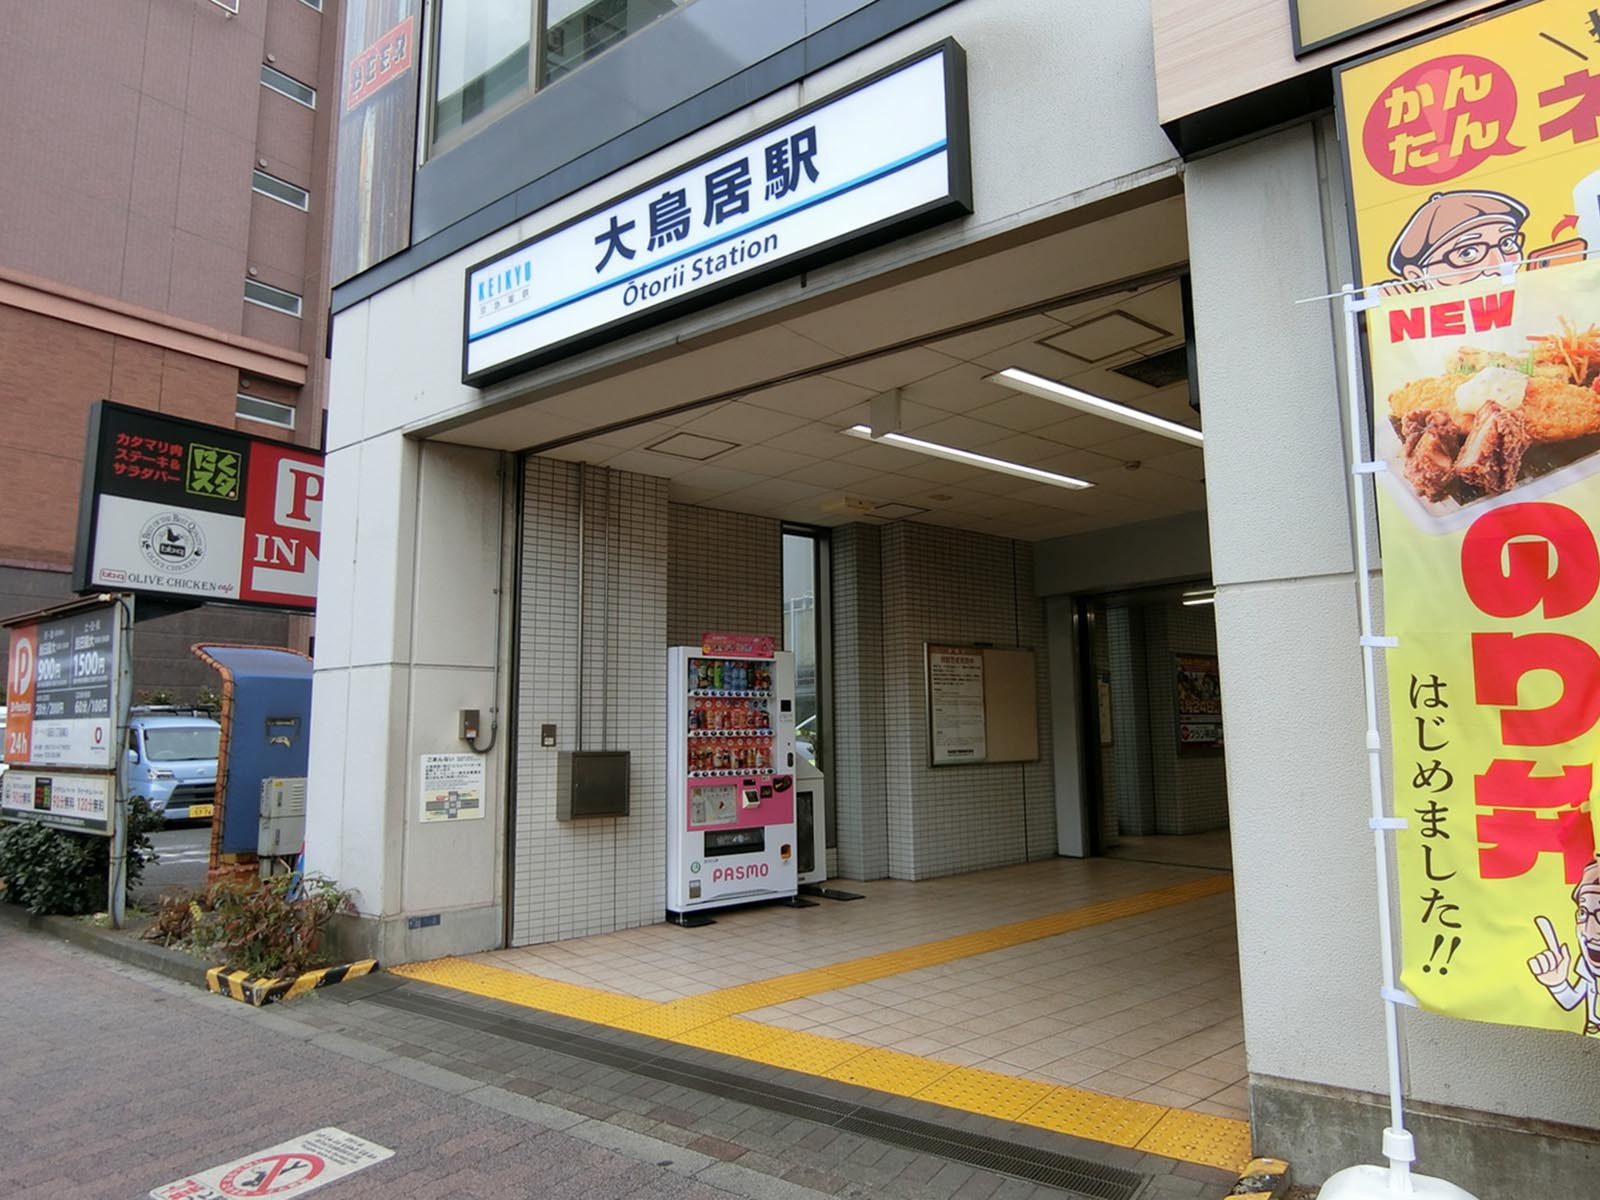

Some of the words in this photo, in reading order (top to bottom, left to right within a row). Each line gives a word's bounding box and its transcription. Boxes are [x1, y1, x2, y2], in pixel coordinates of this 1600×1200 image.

[352, 33, 407, 95] BEER
[1385, 65, 1493, 128] かん
[1388, 112, 1499, 175] たん
[594, 125, 820, 274] 大鳥居駅
[478, 260, 532, 302] KEIKYU
[622, 264, 685, 307] Ōtorii
[691, 233, 778, 282] Station
[1389, 289, 1516, 344] NEW
[116, 432, 184, 457] カタマリ肉
[112, 462, 181, 482] サラダバー
[286, 468, 325, 522] P
[128, 573, 165, 587] OLIVE
[166, 577, 217, 591] CHICKEN
[38, 658, 61, 681] 900円
[73, 651, 105, 677] 1500円
[9, 731, 28, 755] 24h
[713, 863, 769, 882] PASMO
